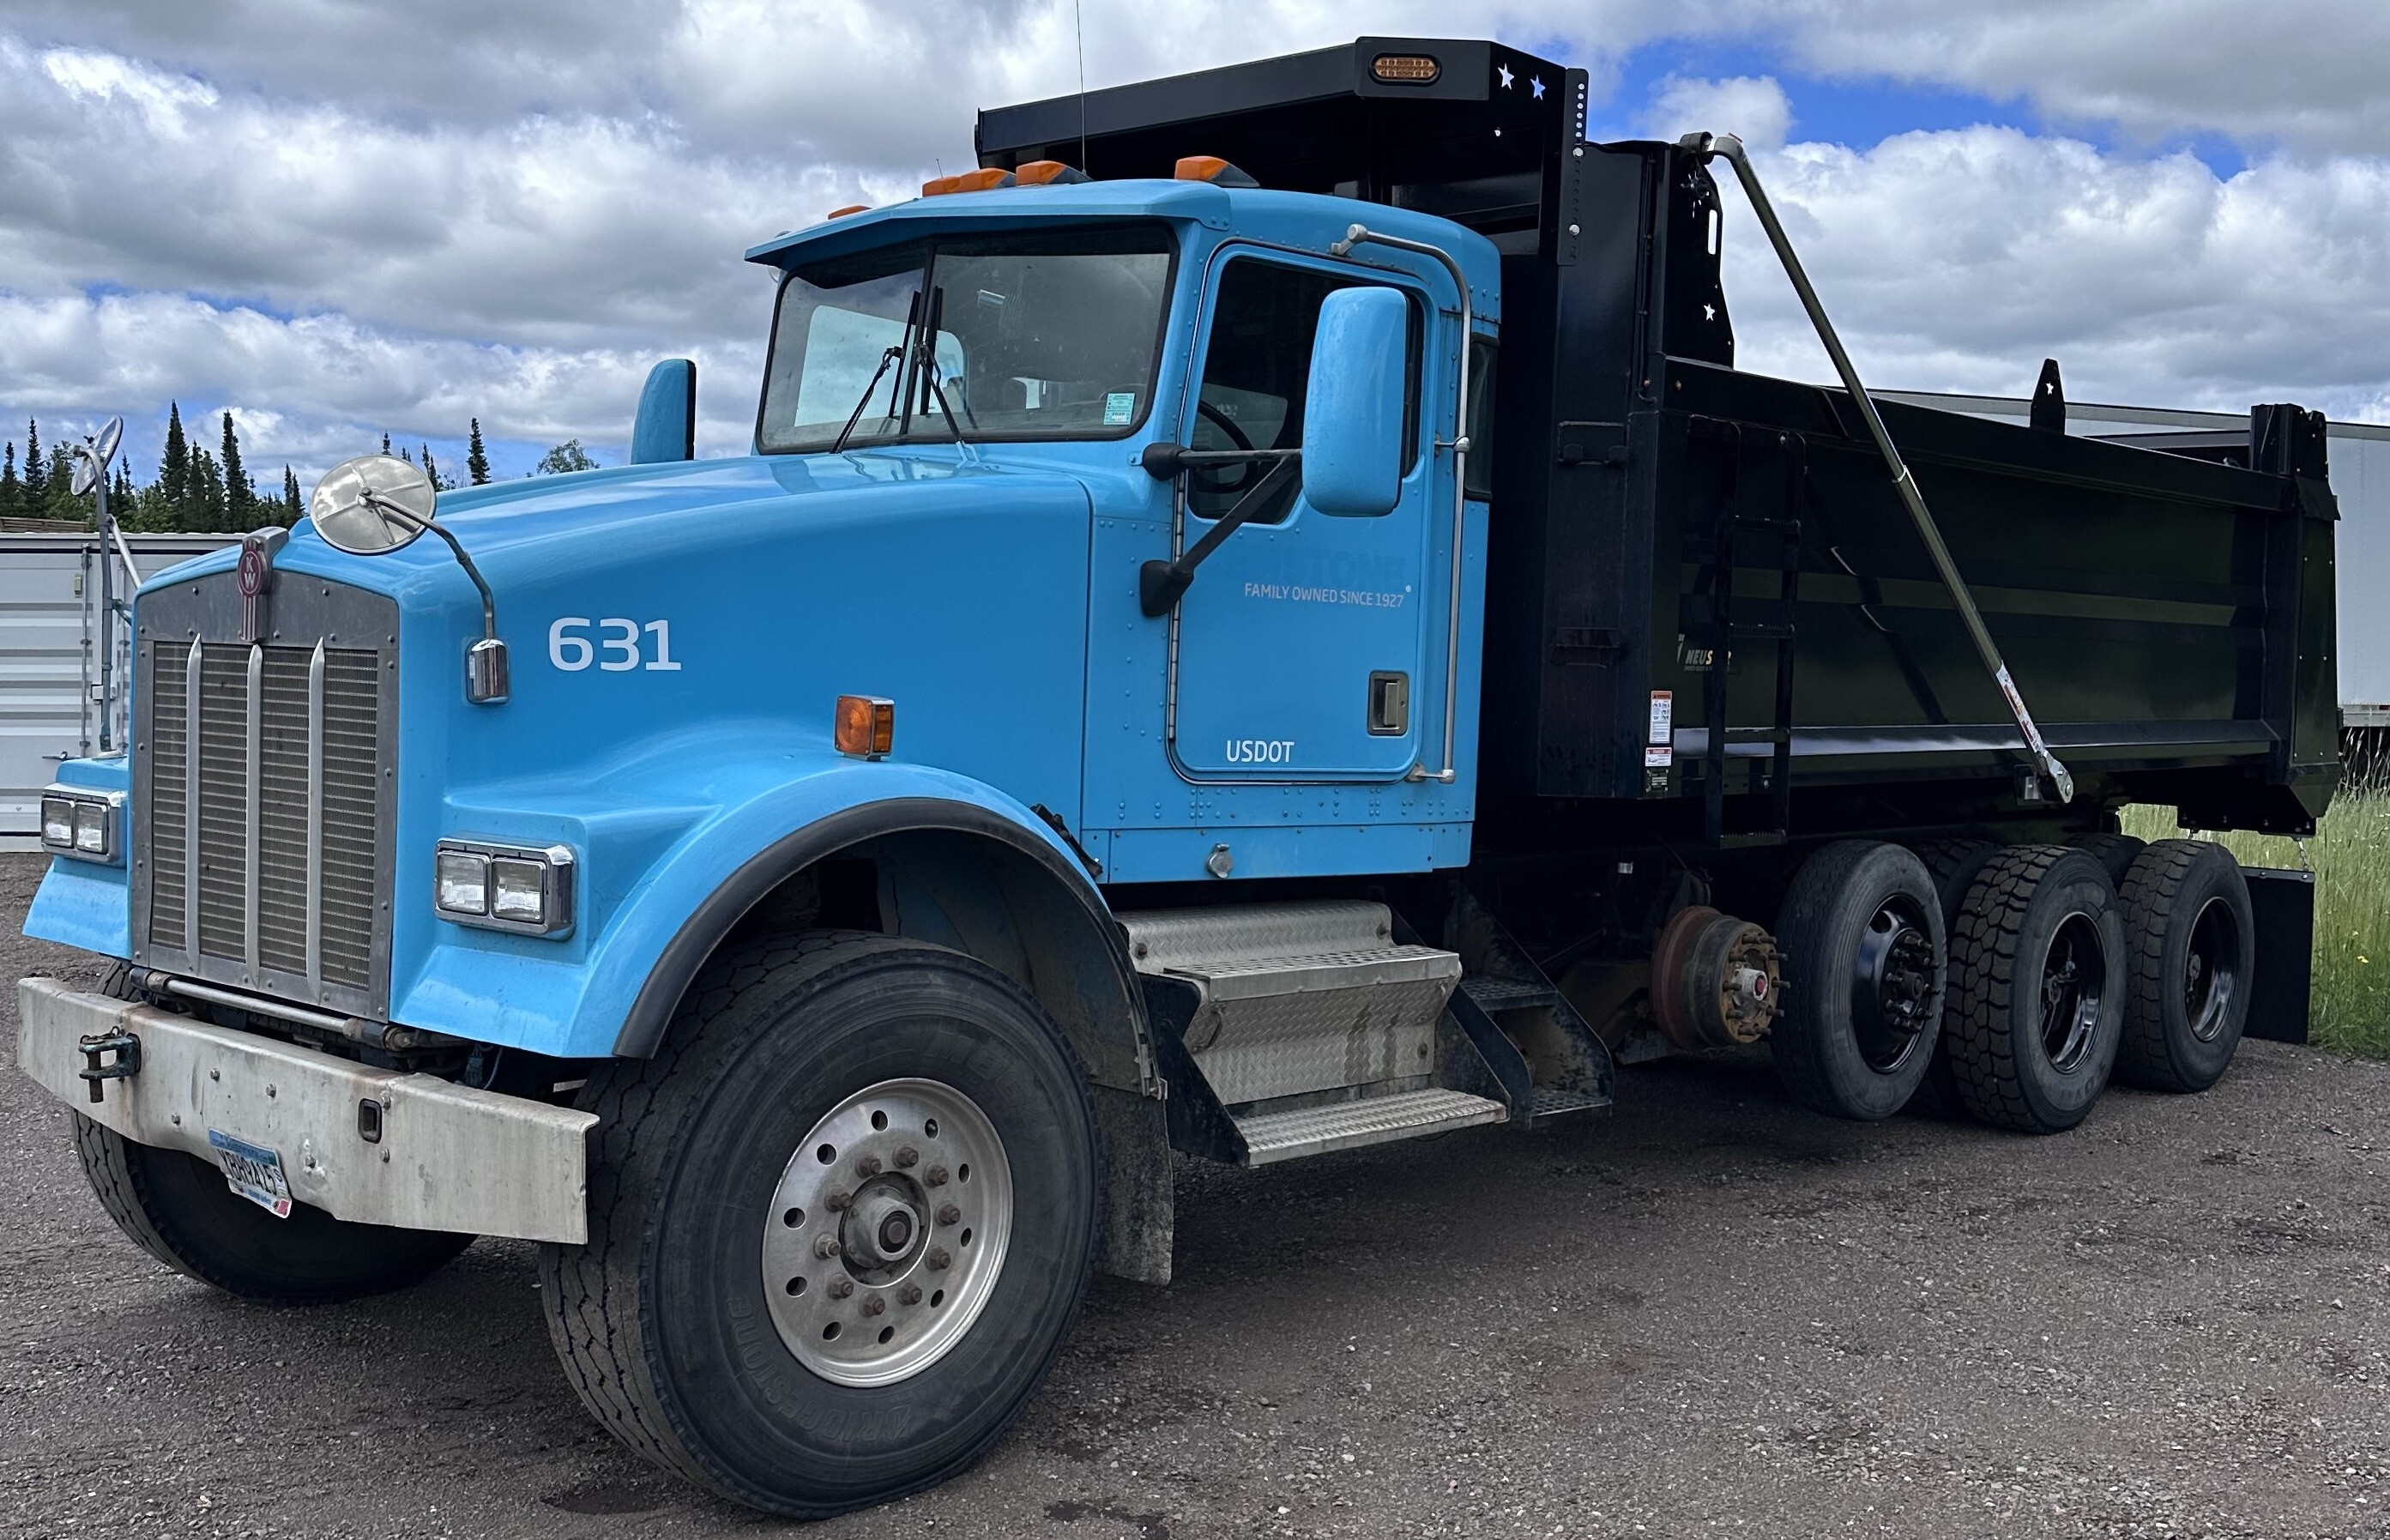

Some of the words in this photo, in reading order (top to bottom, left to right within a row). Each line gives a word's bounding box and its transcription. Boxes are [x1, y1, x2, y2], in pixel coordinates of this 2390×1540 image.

[1244, 583, 1289, 600] FAMILY
[1292, 586, 1337, 602] OWNED
[1340, 591, 1373, 606] SINCE
[1375, 593, 1403, 607] 1927
[549, 617, 681, 672] 631
[1226, 740, 1295, 763] USDOT
